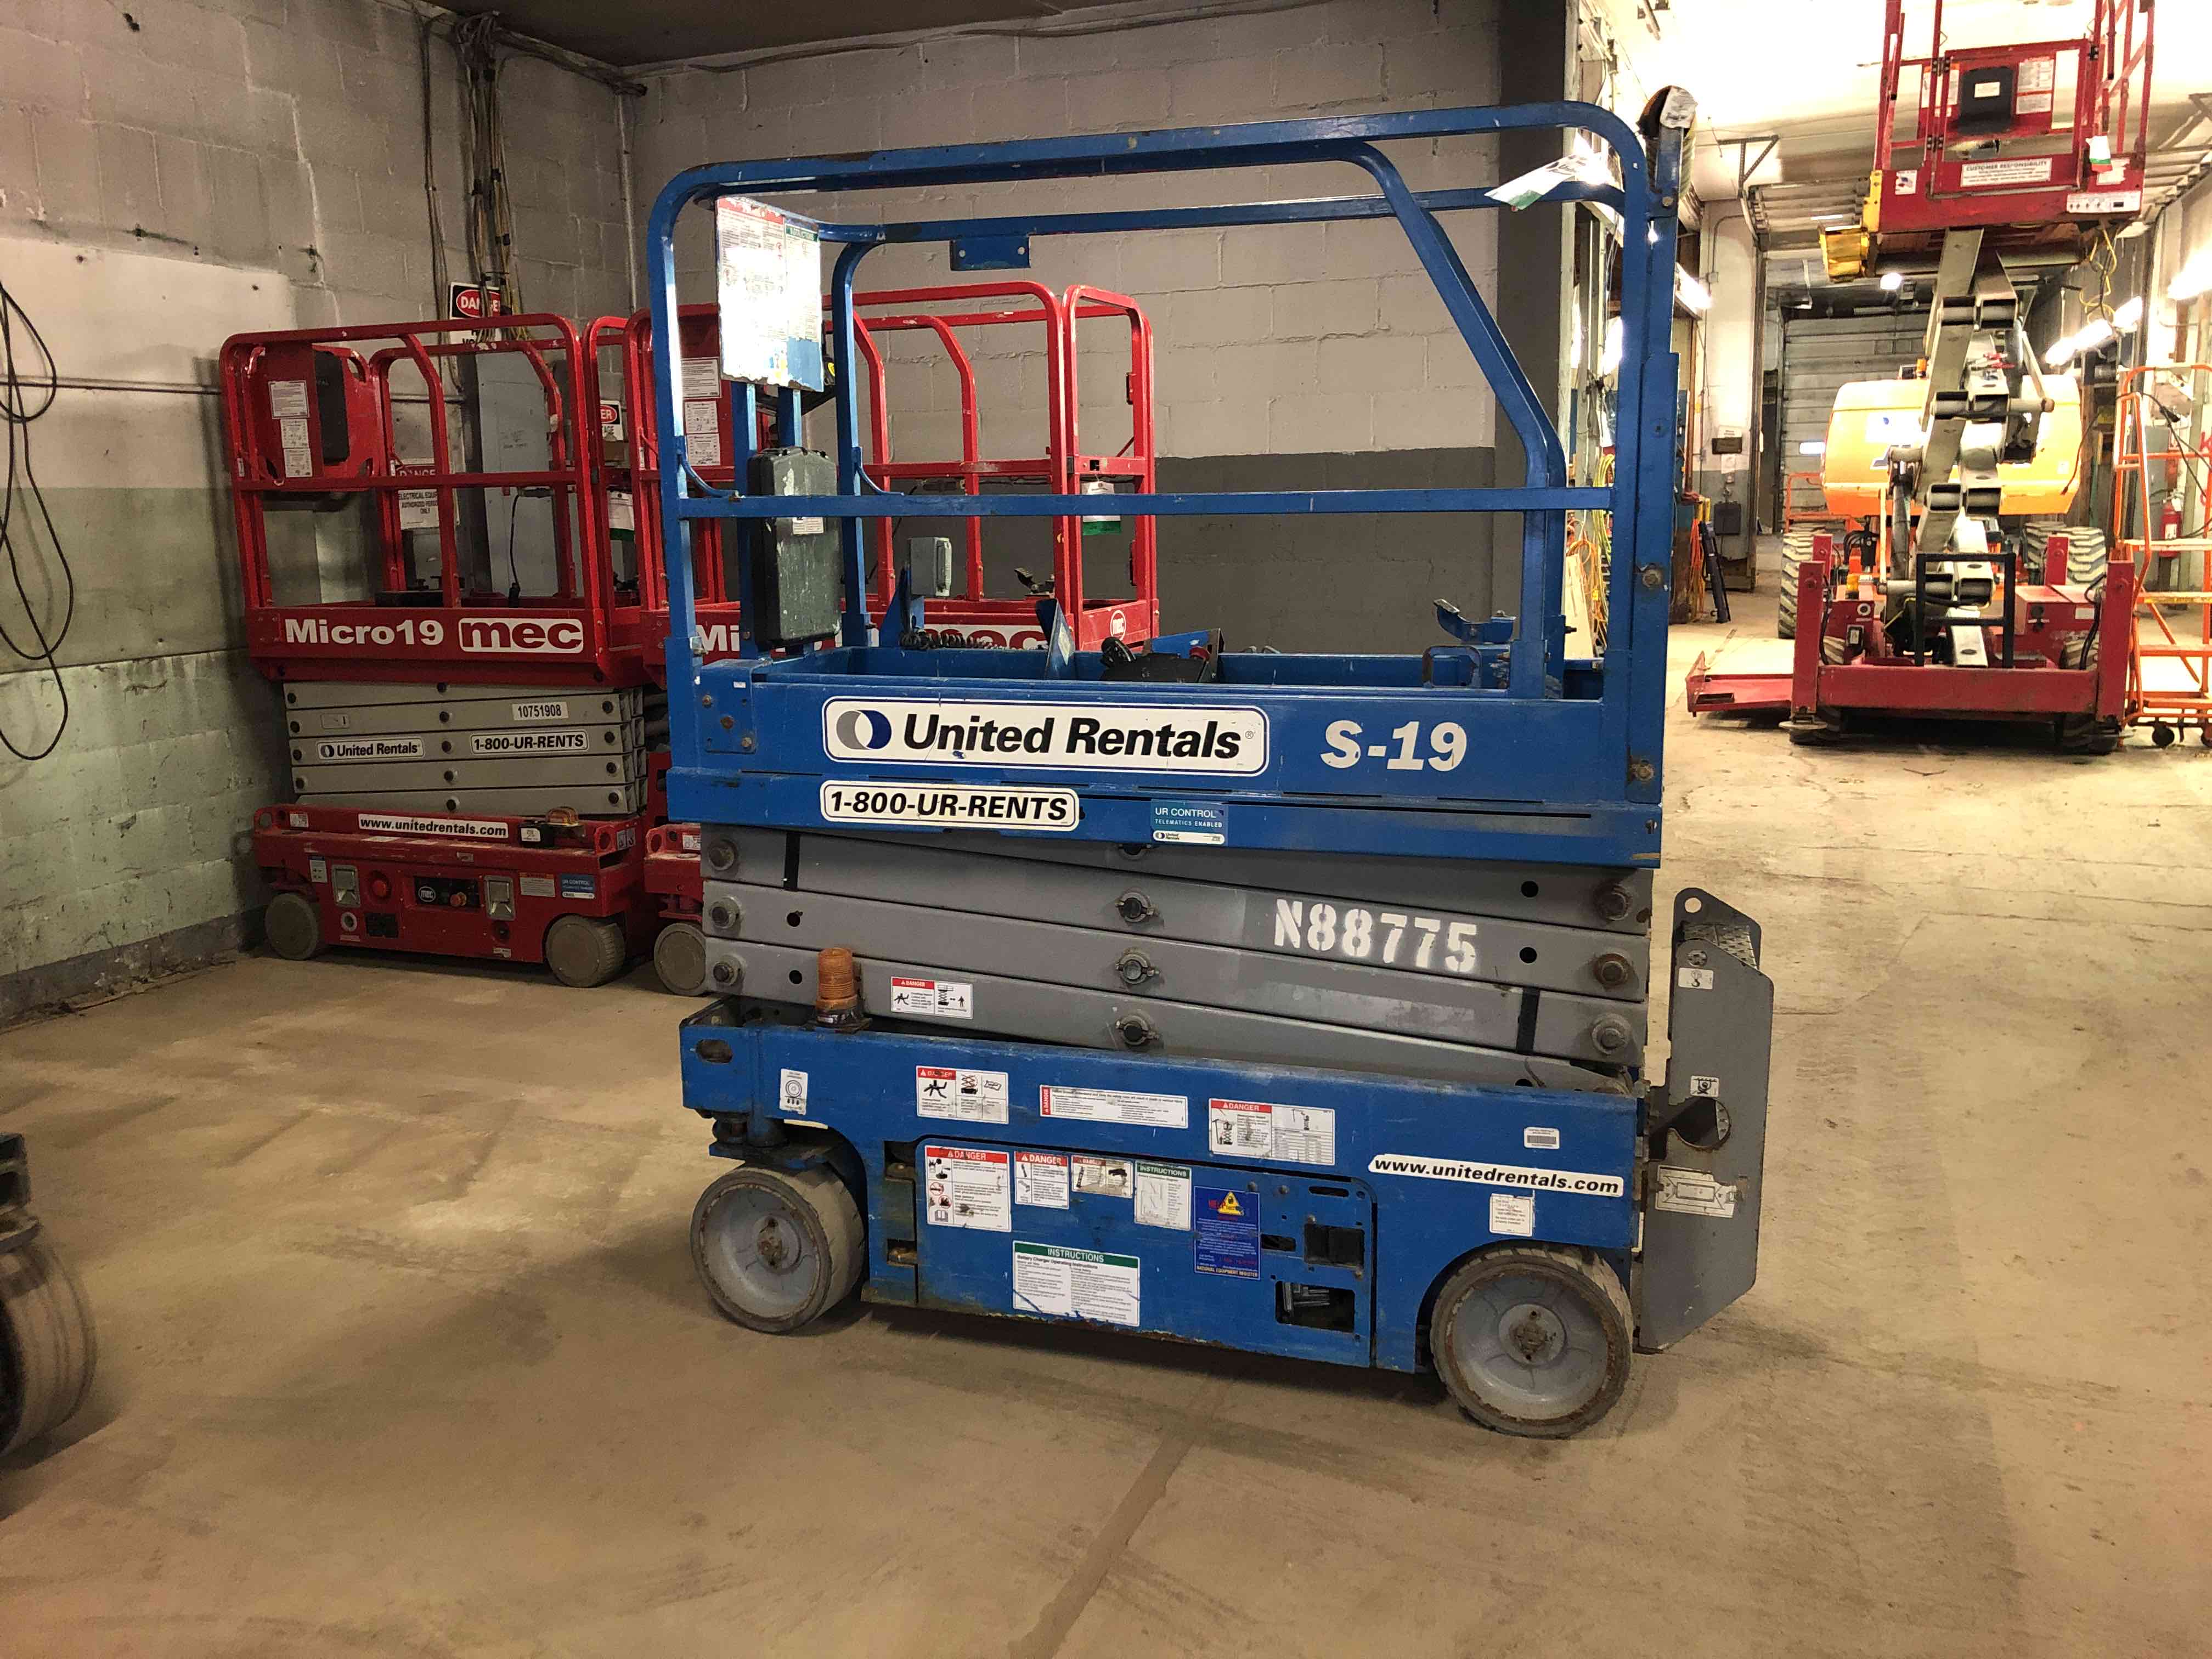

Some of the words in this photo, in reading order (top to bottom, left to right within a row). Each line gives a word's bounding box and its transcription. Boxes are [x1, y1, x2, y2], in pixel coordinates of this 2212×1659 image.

[285, 618, 444, 645] Micro19
[461, 622, 582, 648] mec
[517, 704, 562, 718] 10751908
[903, 713, 1055, 754] United
[337, 743, 374, 757] United
[474, 734, 584, 751] 1-800-UR-RENTS
[1320, 720, 1467, 772] S-19
[830, 791, 1067, 821] 1-800-UR-RENTS
[1155, 807, 1169, 815] UR
[1171, 808, 1216, 818] CONTROL
[360, 818, 506, 837] www.unitedrentals.com
[1274, 899, 1477, 973] N88775
[1229, 1103, 1260, 1111] DANGER
[954, 1150, 987, 1161] DANGER
[1029, 1154, 1062, 1165] DANGER
[1139, 1165, 1187, 1177] INSTRUCTIONS
[1374, 1158, 1620, 1194] www.unitedrentals.com
[1047, 1248, 1104, 1263] INSTRUCTIONS
